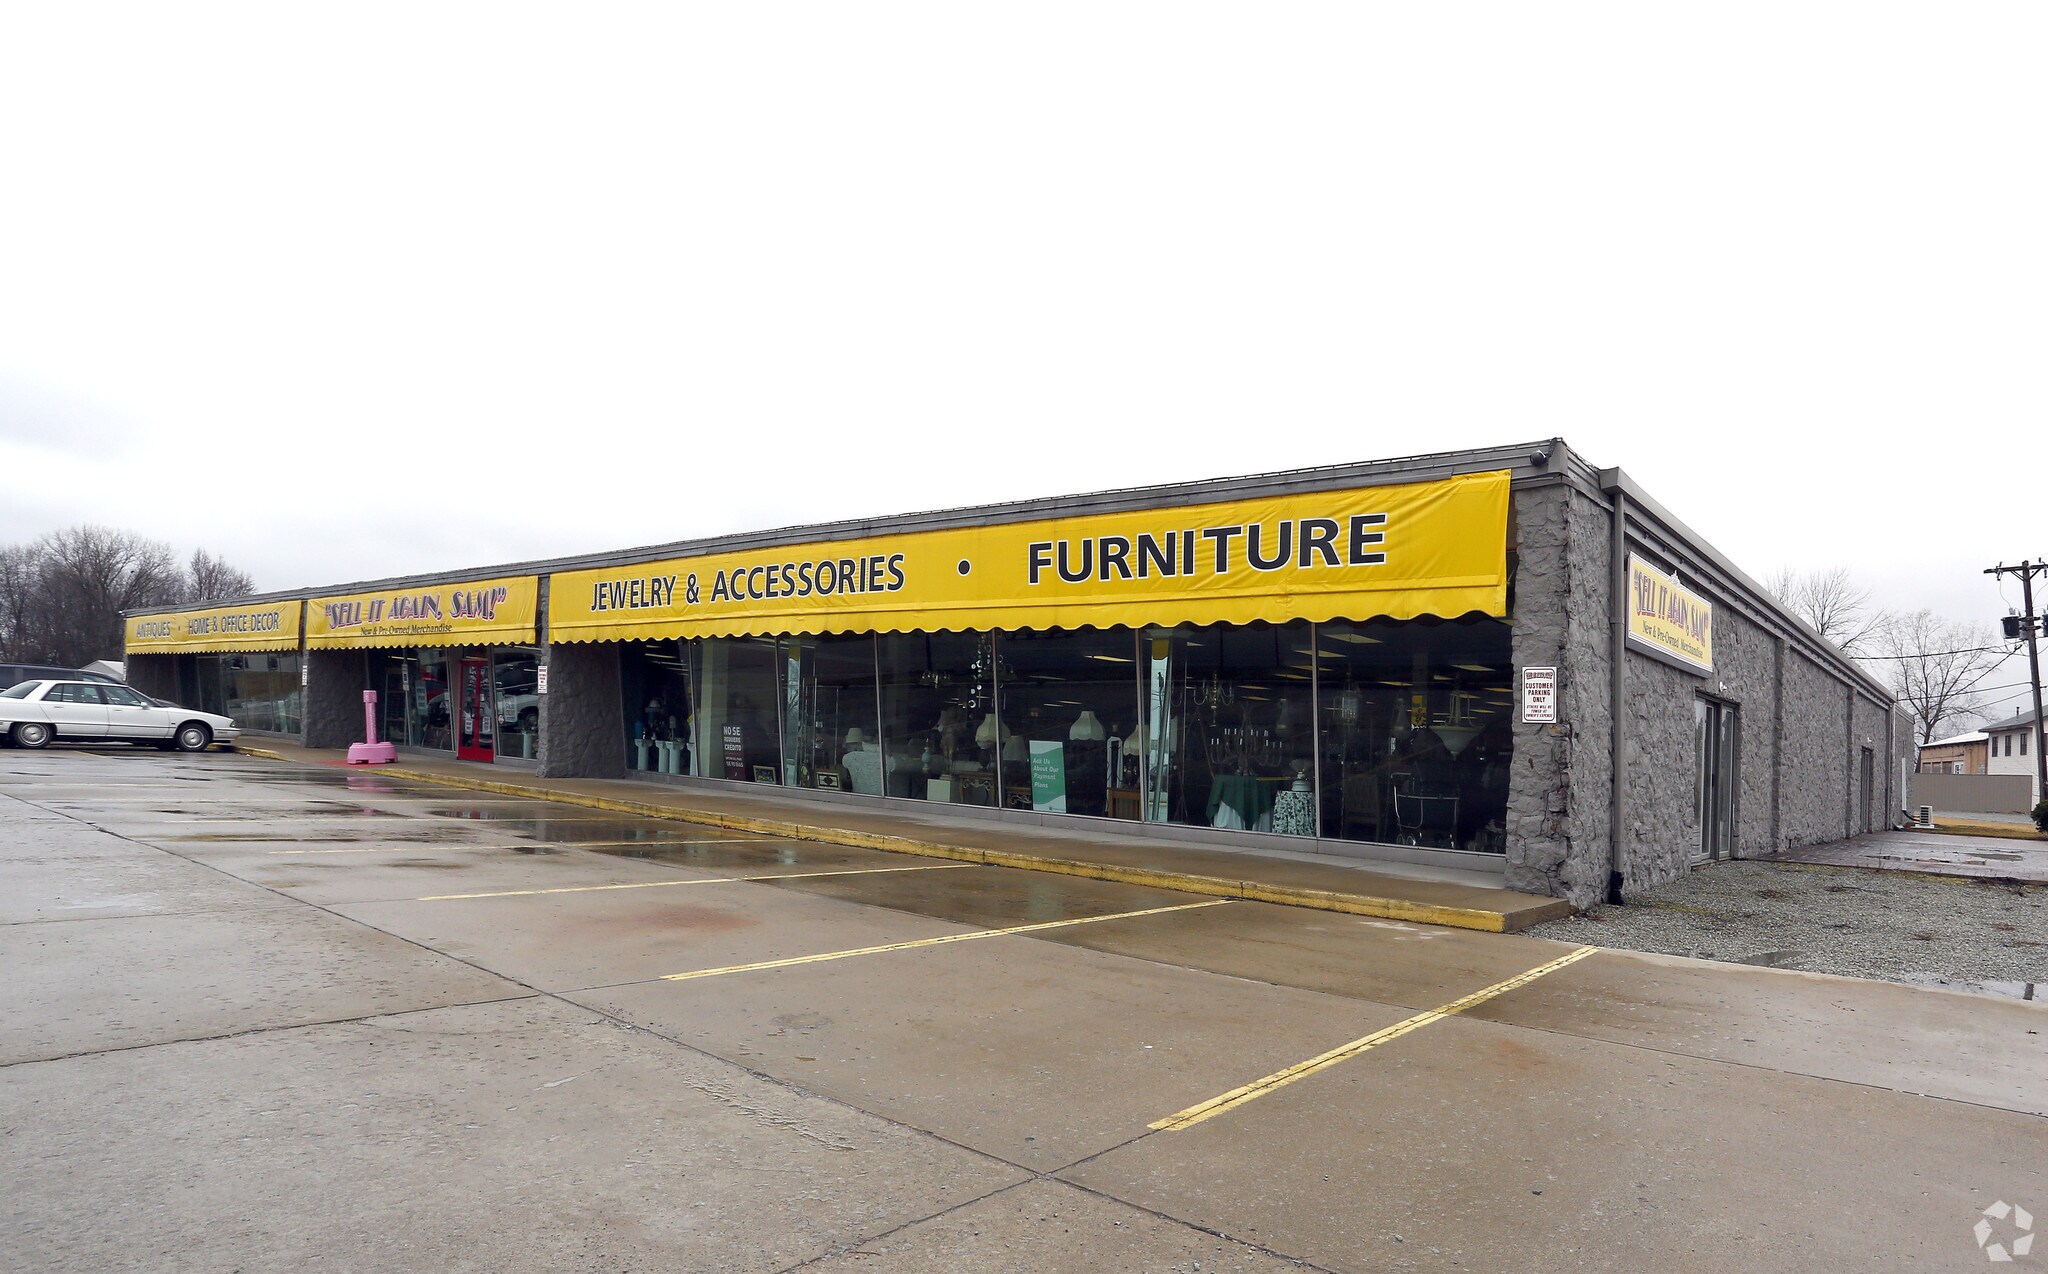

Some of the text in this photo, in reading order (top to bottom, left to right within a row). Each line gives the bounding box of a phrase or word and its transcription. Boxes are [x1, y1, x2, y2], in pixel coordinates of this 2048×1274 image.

[591, 512, 1389, 611] JEWELRY & ACCESSORIES FURNITURE
[368, 599, 385, 623] IT
[450, 587, 507, 620] SAM!"
[1658, 584, 1668, 621] IT
[136, 612, 279, 639] ANTIQUES HOME & OFFICE DECOR
[361, 627, 372, 635] New
[411, 624, 452, 635] Merchandise
[1643, 620, 1653, 635] New
[1657, 627, 1680, 648] Pre-Owned
[724, 726, 740, 736] NO SE
